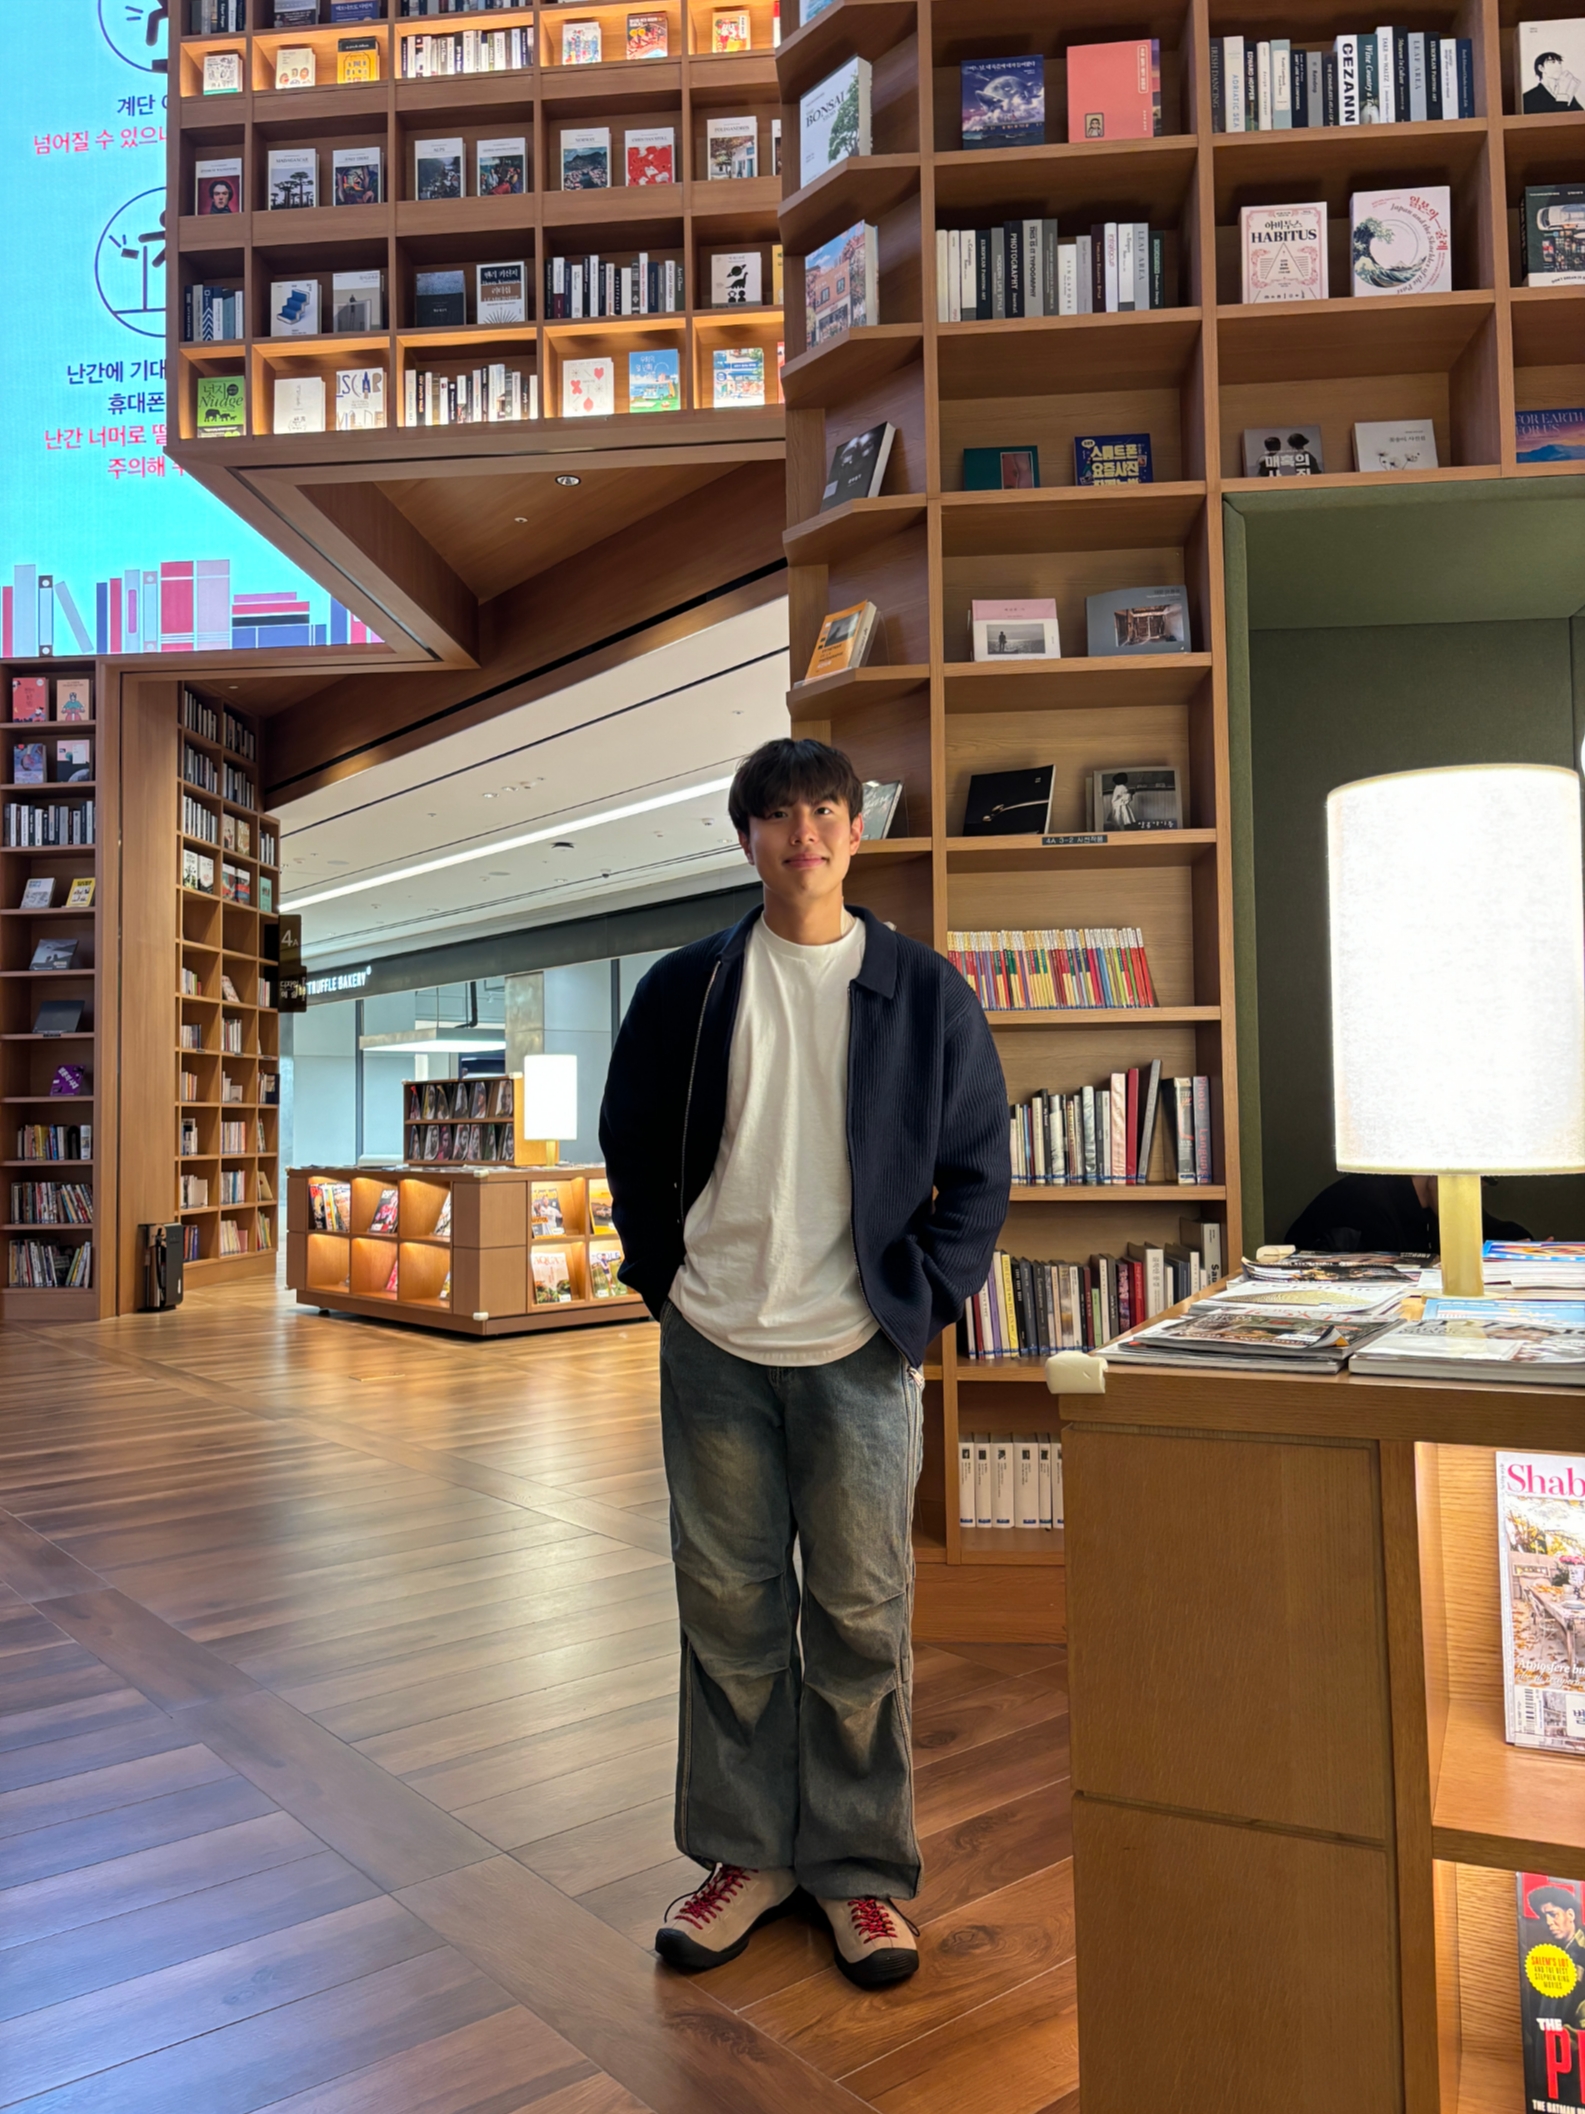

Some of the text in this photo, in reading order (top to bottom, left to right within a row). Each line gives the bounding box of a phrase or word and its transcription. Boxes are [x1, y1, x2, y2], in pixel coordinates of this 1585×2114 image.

[1365, 44, 1373, 63] Wine
[1365, 65, 1373, 91] Country
[1211, 70, 1219, 108] DANCING
[117, 95, 155, 116] 계단
[806, 91, 845, 128] BONSAI
[34, 131, 89, 154] 넘어질
[96, 130, 114, 150] 수
[1265, 220, 1303, 230] 아비투스
[1409, 195, 1448, 250] 일본의 굴레
[1251, 229, 1317, 243] HABITUS
[1391, 203, 1412, 214] Japan
[1412, 214, 1425, 225] and
[1423, 224, 1431, 234] the
[1427, 235, 1436, 267] Shackles
[1010, 233, 1018, 290] PHOTOGRAPHY
[67, 360, 123, 385] 난간에
[204, 383, 225, 399] 넛지
[108, 392, 165, 414] 휴대폰
[199, 395, 244, 409] Nudge
[1516, 412, 1584, 425] FOR EARTH
[45, 428, 83, 450] 난간
[89, 426, 146, 448] 너머로
[1516, 424, 1560, 435] FOR US
[108, 456, 165, 479] 주의해
[281, 930, 299, 947] 4A
[306, 977, 337, 995] TRUFFLE
[338, 972, 366, 989] BAKERY
[1197, 1076, 1207, 1110] Photo
[1506, 1463, 1585, 1498] Shab
[1518, 1659, 1570, 1673] Atmosfere
[1531, 1956, 1557, 1967] SALEM'S
[1534, 1973, 1556, 1981] STEPHEN
[1543, 1981, 1563, 1989] MOVIES
[1536, 2017, 1563, 2031] THE
[1532, 2100, 1576, 2114] THE BATMAN
